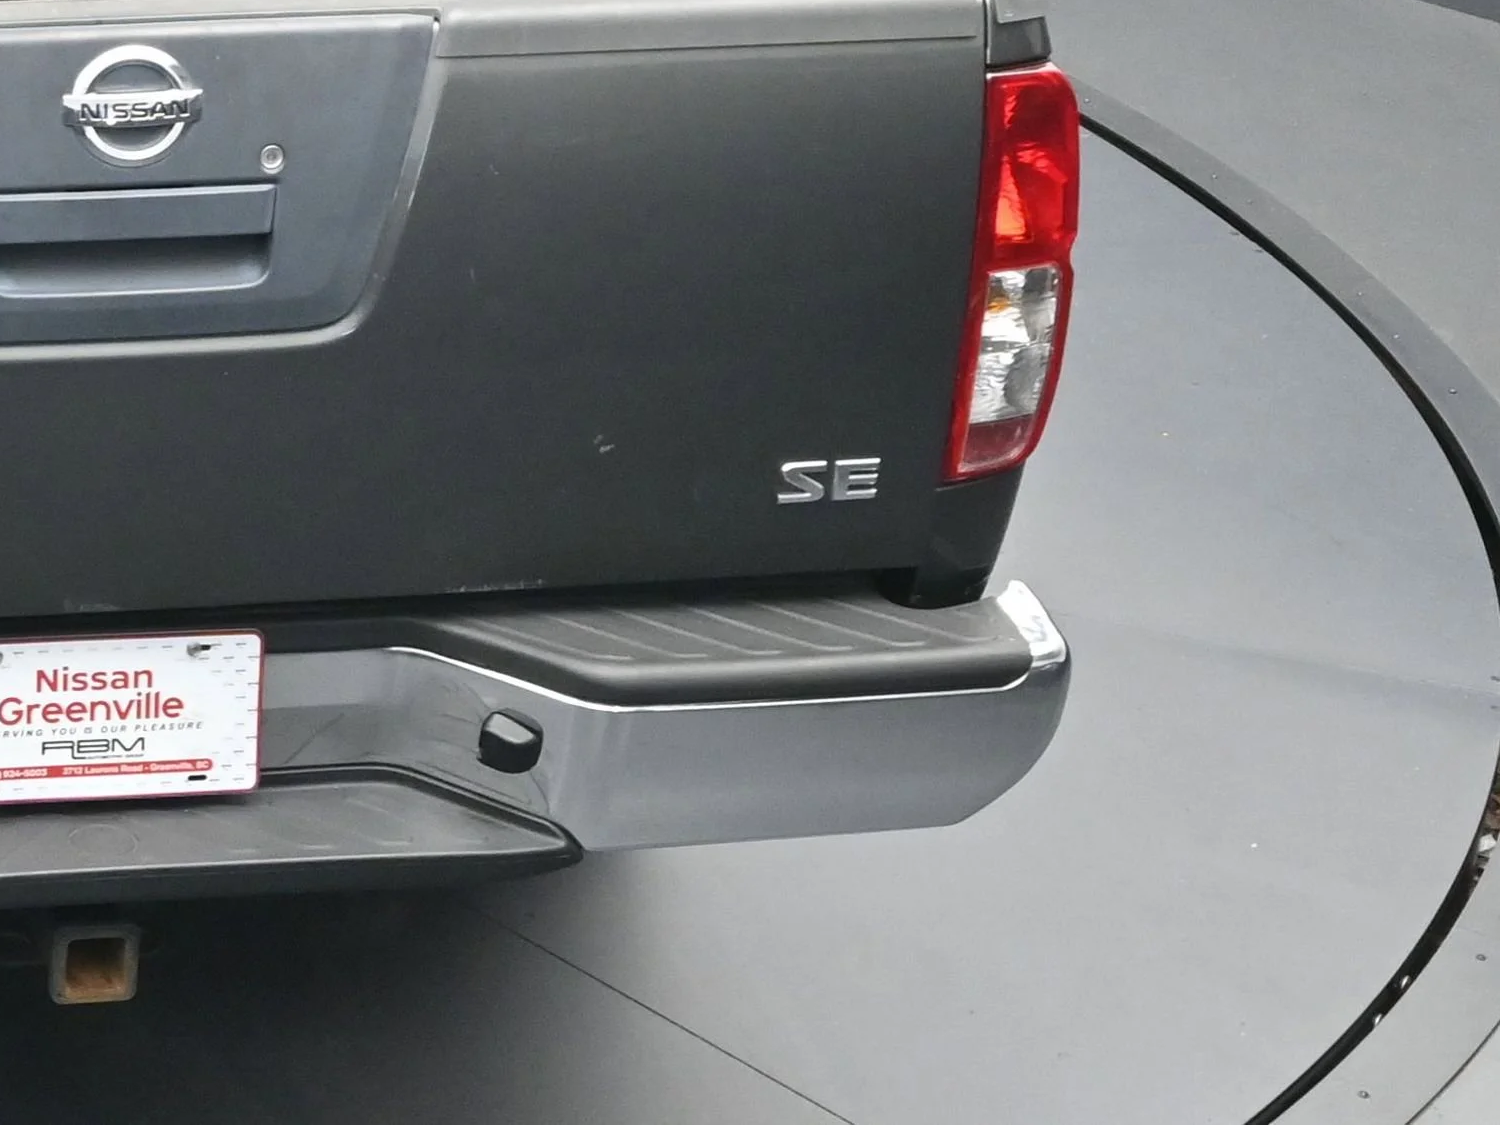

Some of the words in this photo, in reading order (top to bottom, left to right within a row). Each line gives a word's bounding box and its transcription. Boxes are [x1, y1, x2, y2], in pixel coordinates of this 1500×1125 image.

[80, 99, 190, 120] NISSAN
[777, 457, 881, 504] SE
[36, 666, 153, 693] Nissan
[52, 726, 78, 737] YOU
[101, 724, 127, 734] OUR
[134, 721, 205, 732] PLEASURE
